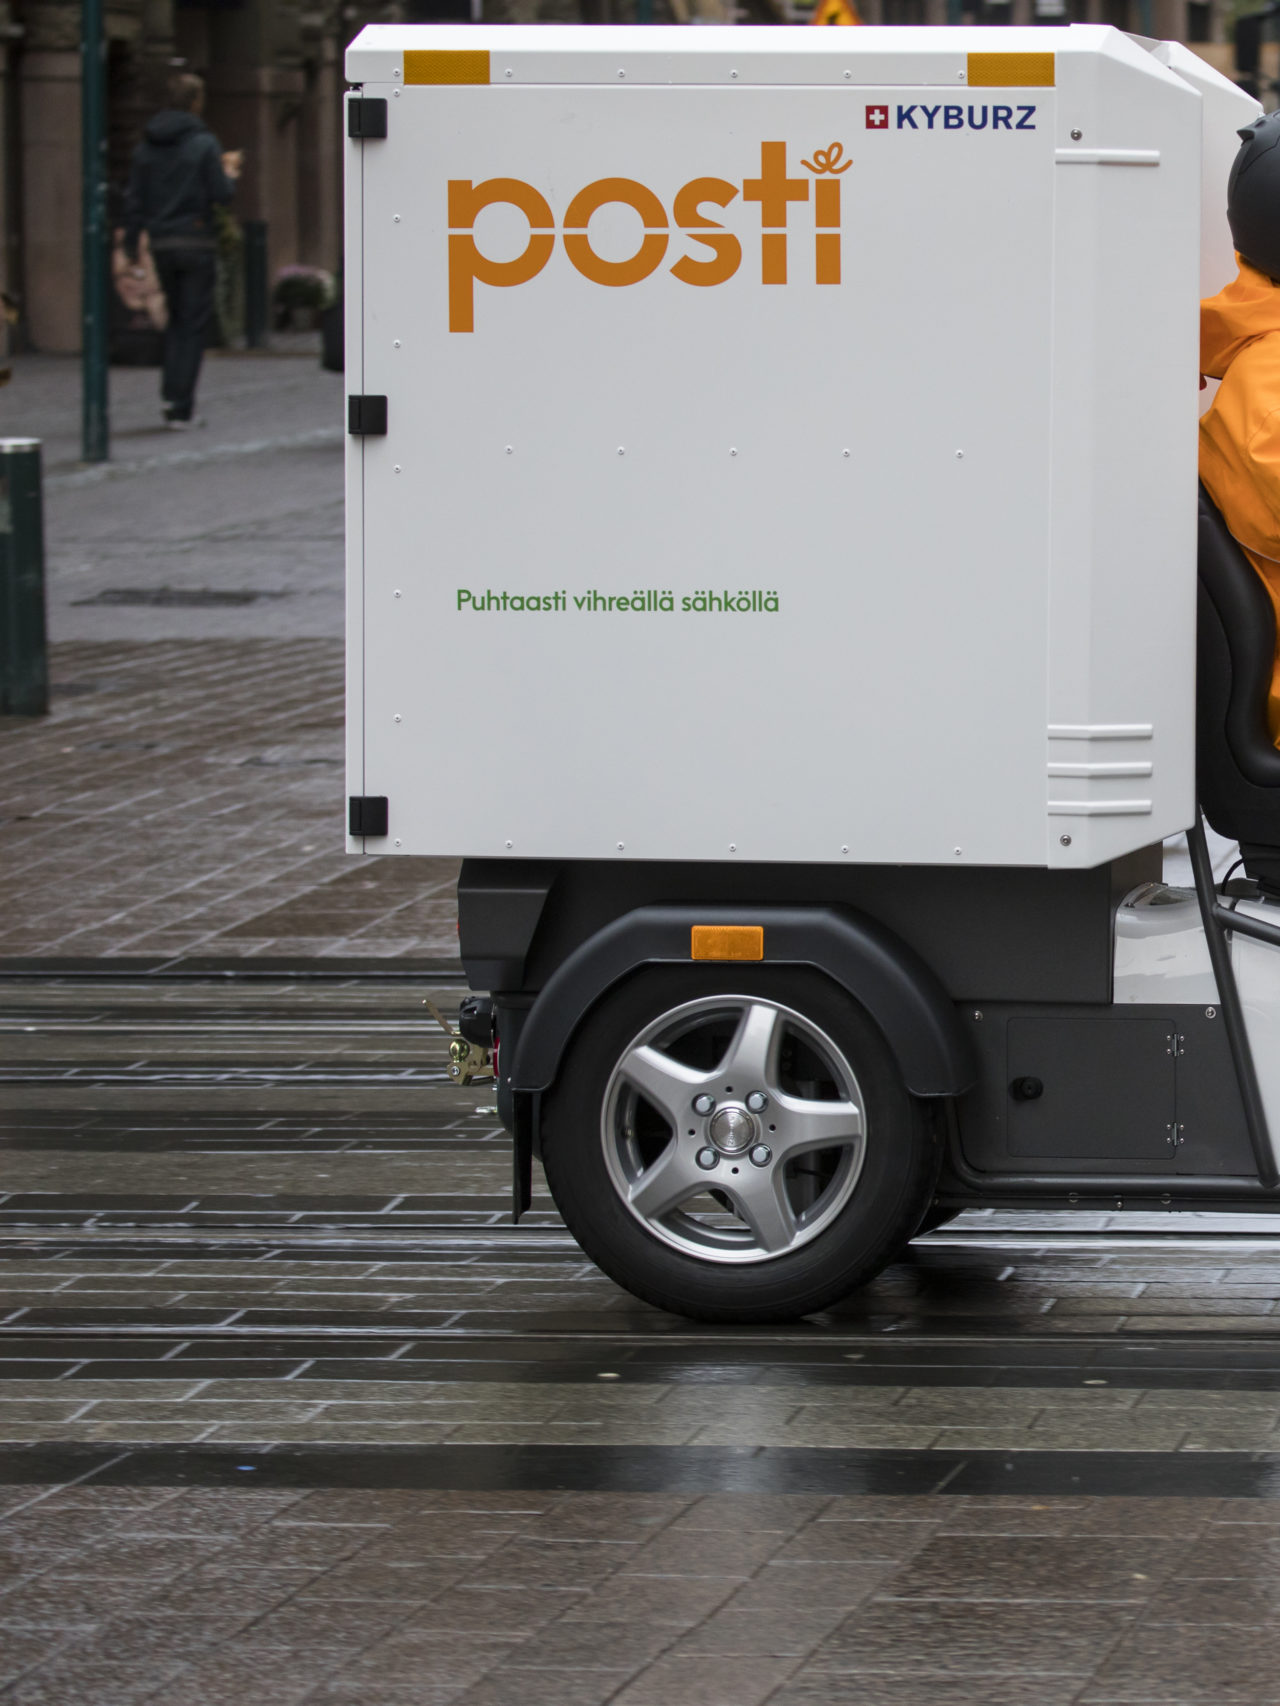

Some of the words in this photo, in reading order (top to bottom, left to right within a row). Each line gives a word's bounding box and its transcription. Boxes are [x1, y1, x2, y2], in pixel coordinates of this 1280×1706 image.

[896, 105, 1036, 130] KYBURZ
[447, 141, 853, 333] posti
[456, 589, 567, 612] Puhtaasti
[573, 589, 674, 613] vihreällä
[681, 590, 779, 613] sähköllä
